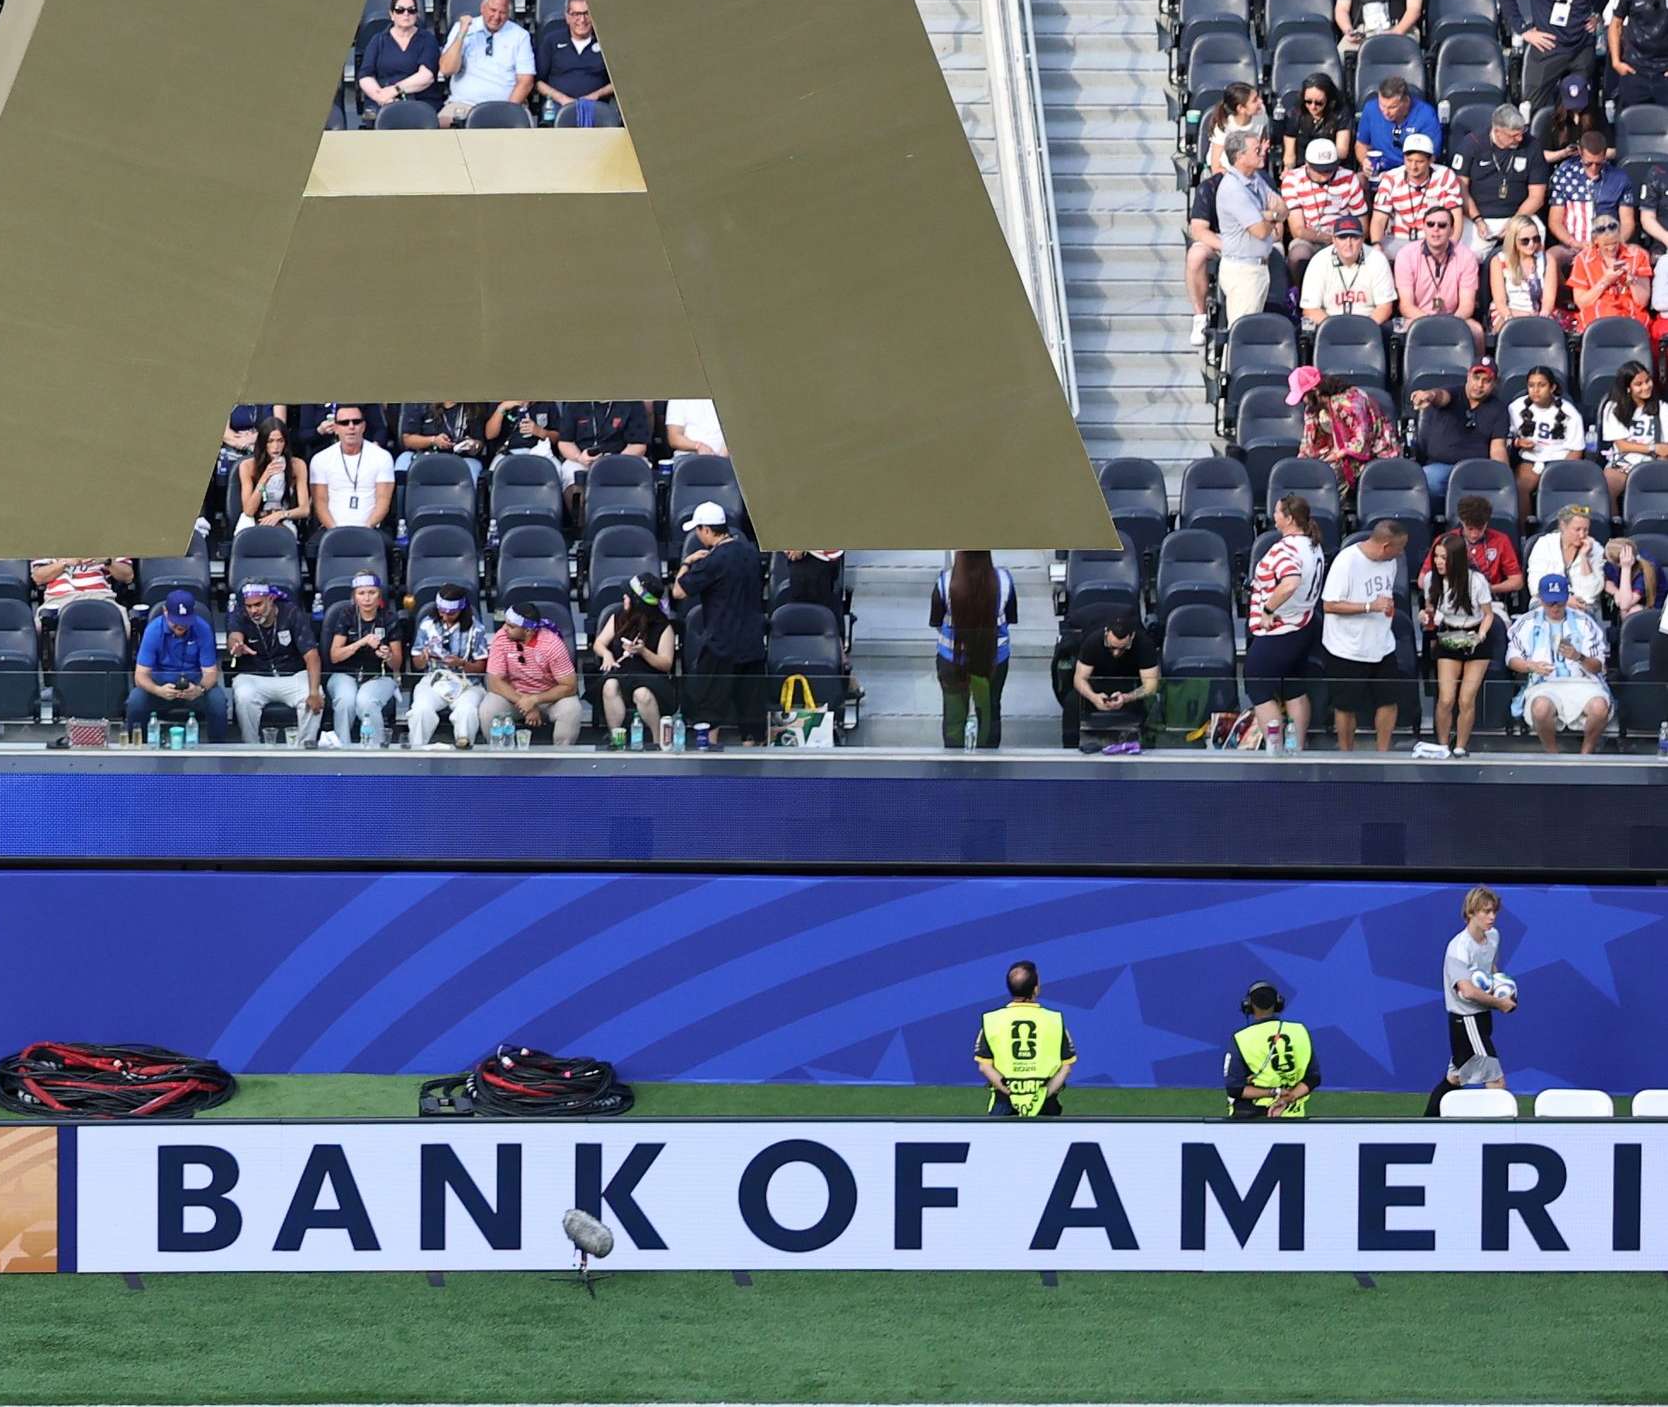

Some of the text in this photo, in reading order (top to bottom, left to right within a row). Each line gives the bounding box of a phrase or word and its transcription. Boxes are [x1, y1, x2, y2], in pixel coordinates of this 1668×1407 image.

[1335, 291, 1367, 306] USA
[1364, 576, 1393, 597] USA
[156, 1138, 1642, 1253] BANK OF AMERI
